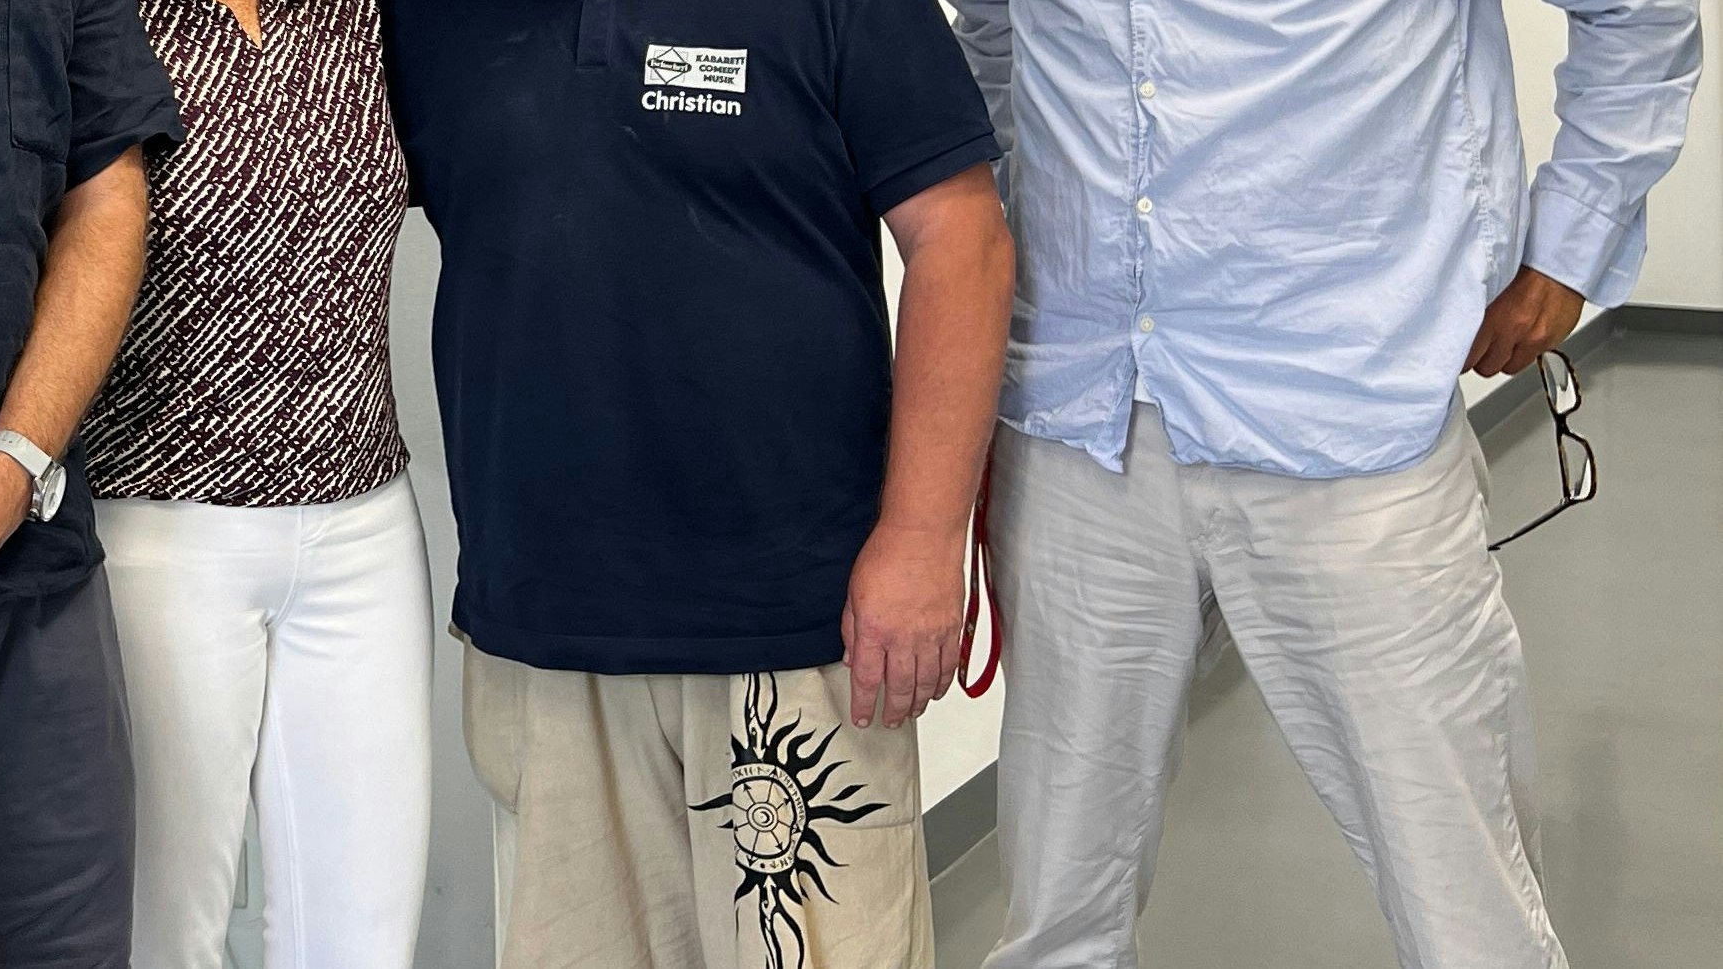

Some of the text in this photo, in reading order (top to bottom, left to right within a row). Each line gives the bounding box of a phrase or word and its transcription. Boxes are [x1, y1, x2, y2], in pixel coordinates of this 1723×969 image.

[696, 55, 746, 65] KABARETT
[699, 65, 740, 75] COMEDY
[703, 75, 735, 84] MUSIK
[641, 90, 741, 116] Christian
